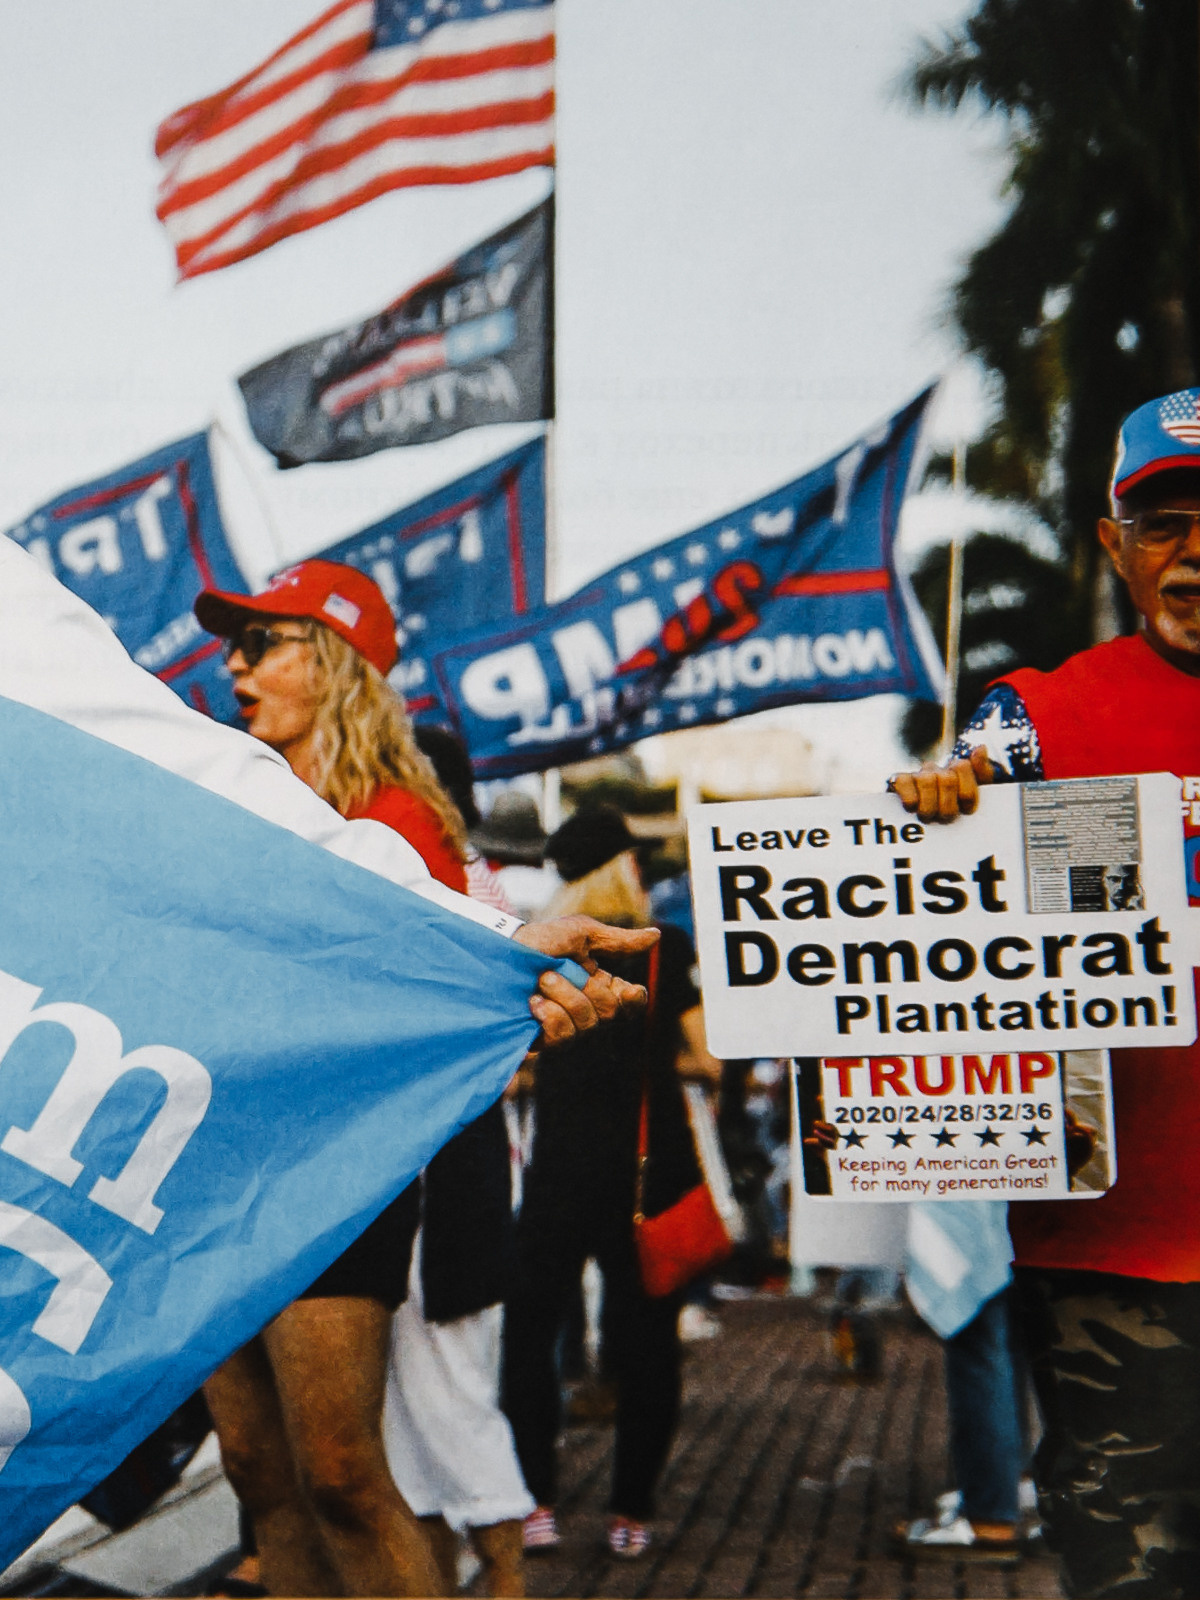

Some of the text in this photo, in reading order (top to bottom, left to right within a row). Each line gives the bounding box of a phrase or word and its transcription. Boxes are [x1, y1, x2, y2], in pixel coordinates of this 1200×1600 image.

[710, 818, 926, 853] Leave The
[717, 854, 1010, 922] Racist
[724, 916, 1173, 988] Democrat
[834, 984, 1179, 1035] Plantation!
[823, 1052, 1058, 1099] TRUMP
[833, 1103, 1054, 1125] 2020/24/28/32/36
[838, 1153, 1059, 1176] Keeping American Great
[850, 1173, 1050, 1196] for many generations!
